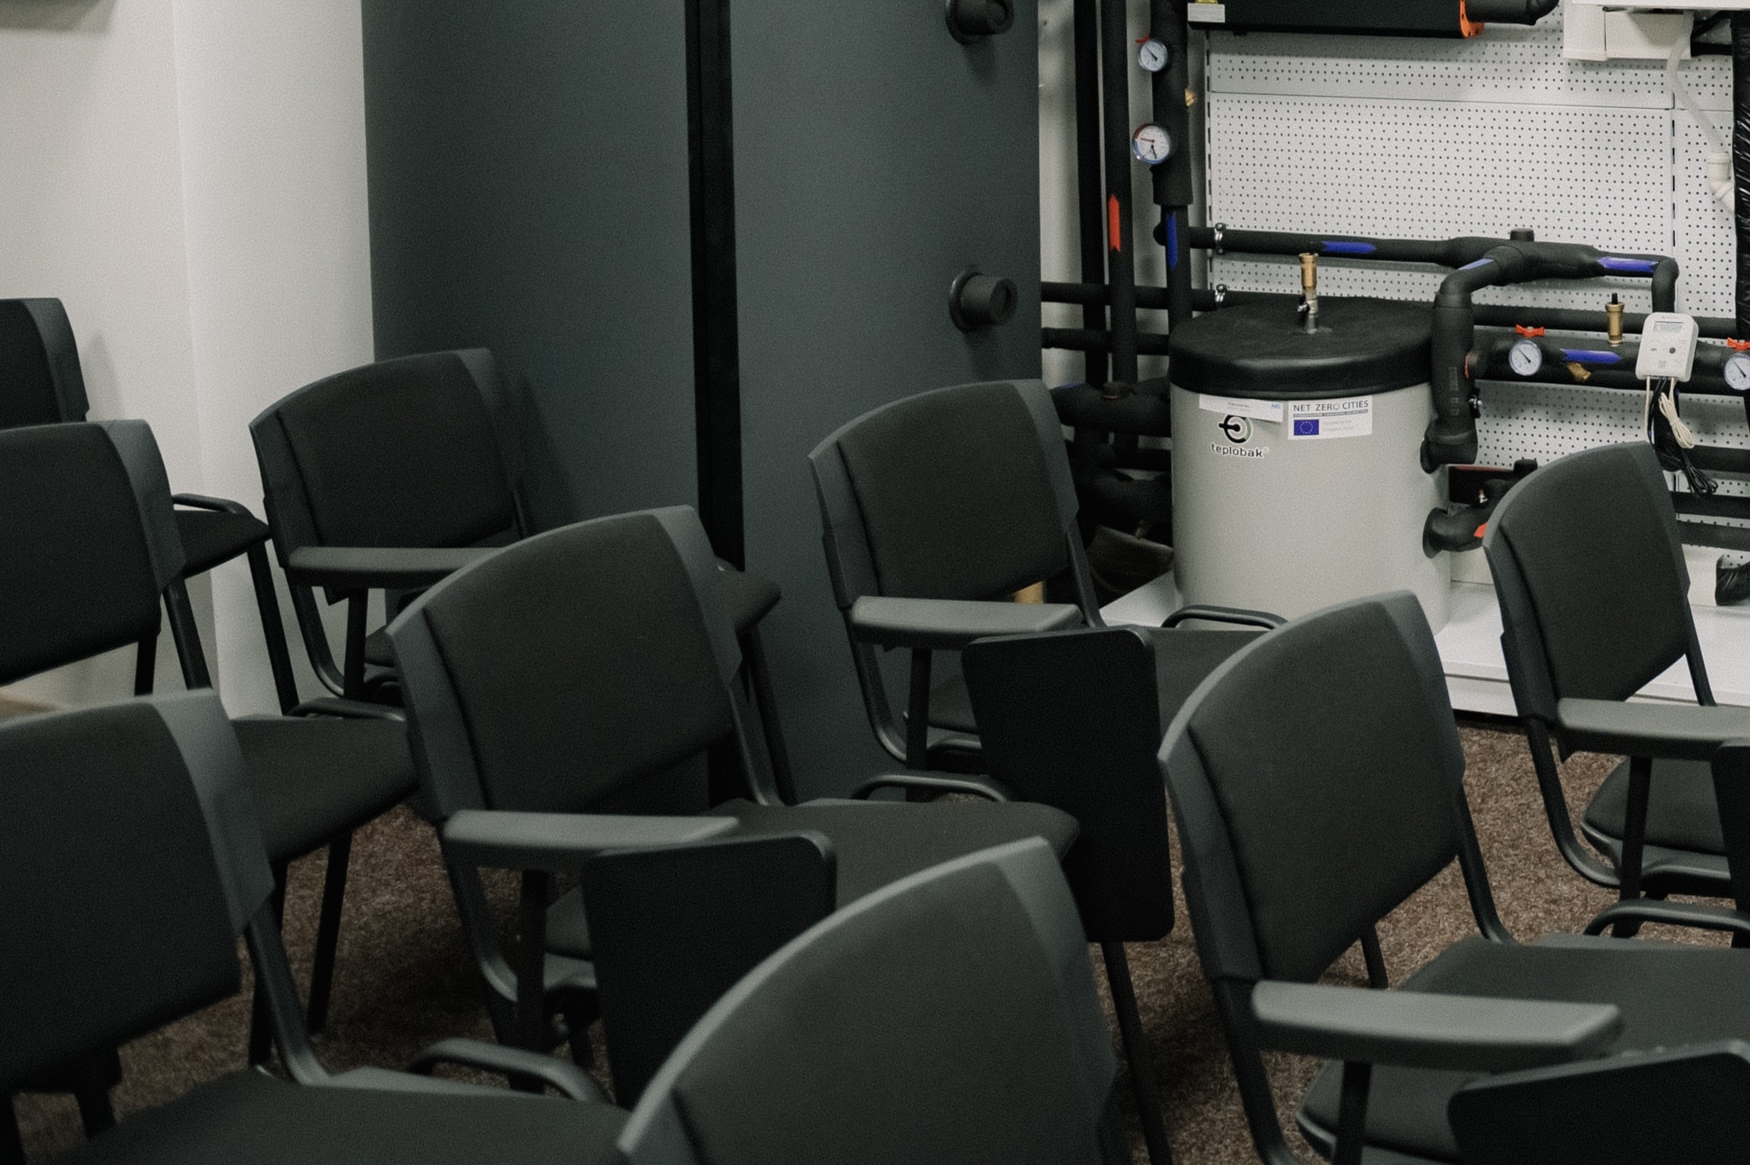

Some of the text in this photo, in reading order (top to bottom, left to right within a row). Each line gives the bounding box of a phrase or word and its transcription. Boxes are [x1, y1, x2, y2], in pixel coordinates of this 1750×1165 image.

[1293, 400, 1369, 412] NET ZERO CITIES
[1211, 443, 1263, 458] teplobak
